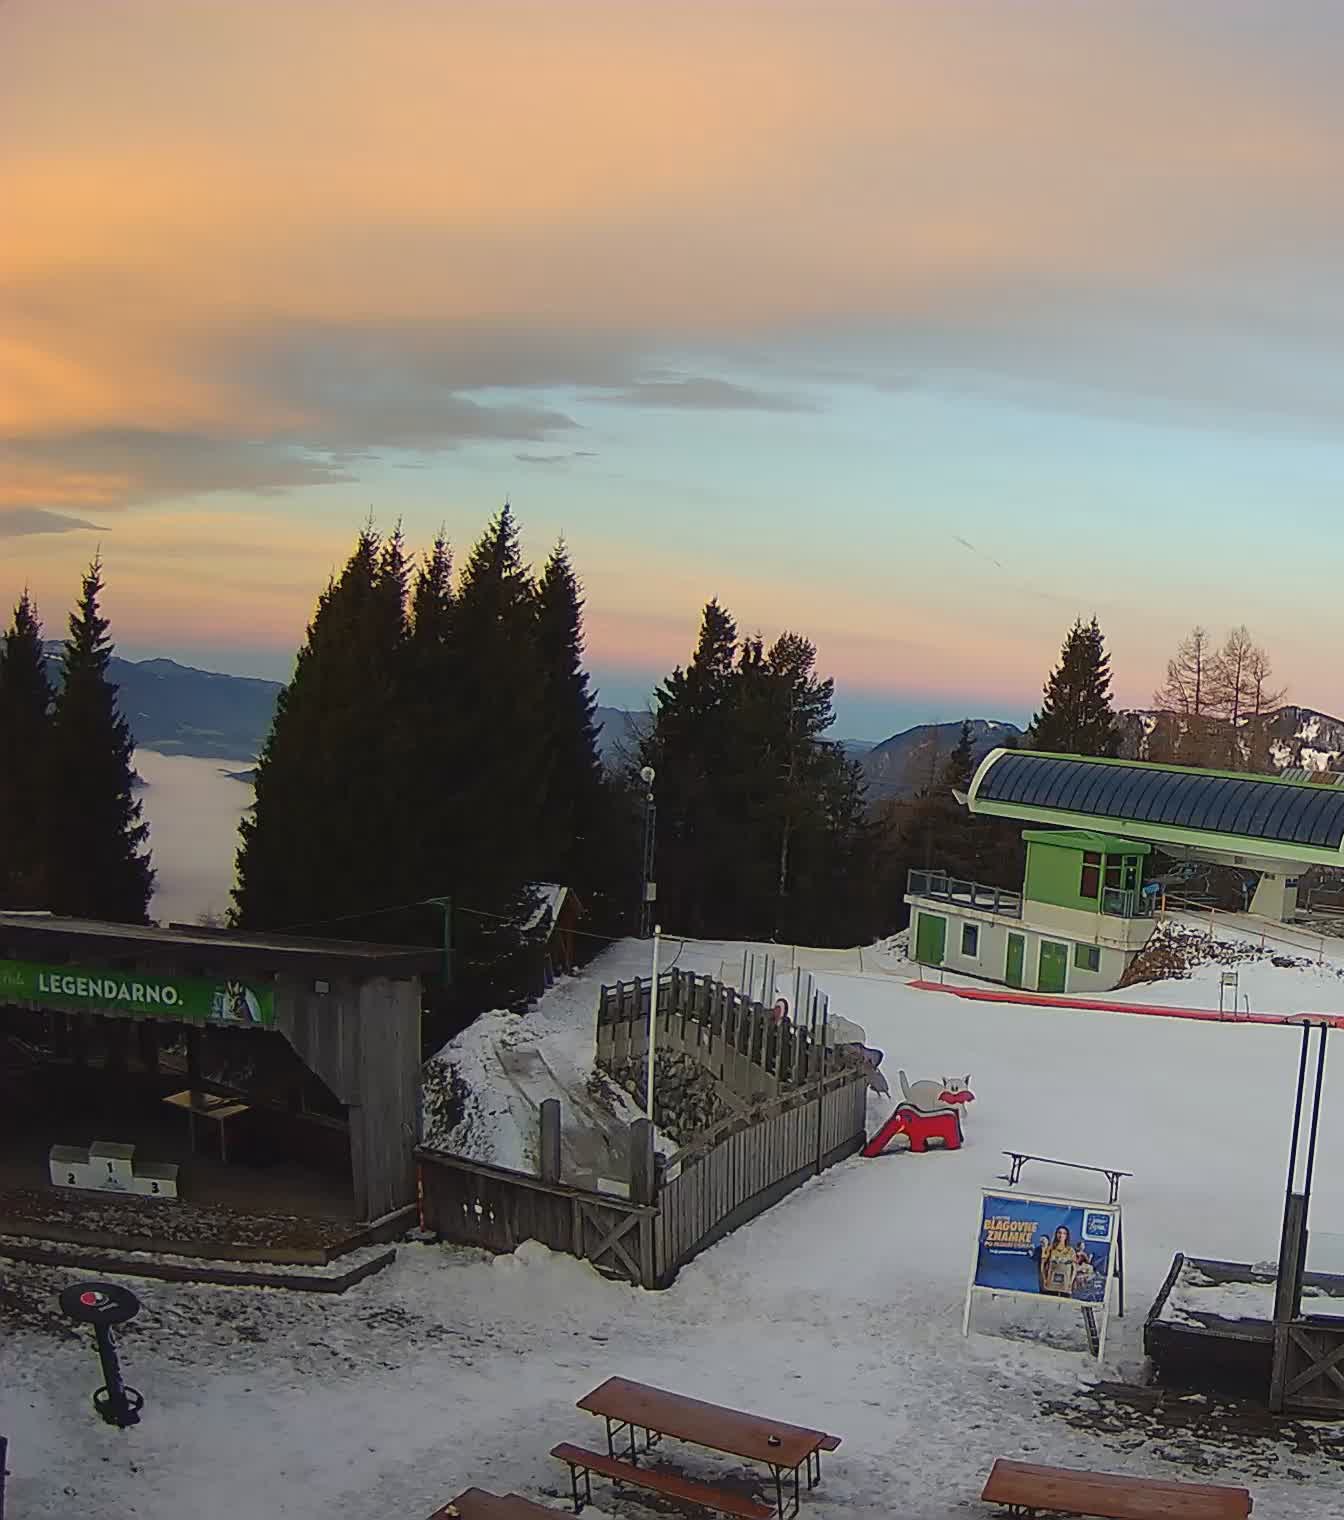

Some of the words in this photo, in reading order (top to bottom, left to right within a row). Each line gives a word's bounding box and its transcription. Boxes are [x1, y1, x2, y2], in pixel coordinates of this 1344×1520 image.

[38, 973, 184, 1005] LEGENDARNO.
[105, 1161, 113, 1173] 1
[68, 1173, 76, 1185] 2
[151, 1182, 160, 1194] 3
[984, 1219, 1038, 1232] BLAGOVNE
[986, 1230, 1032, 1243] ZNAMKE
